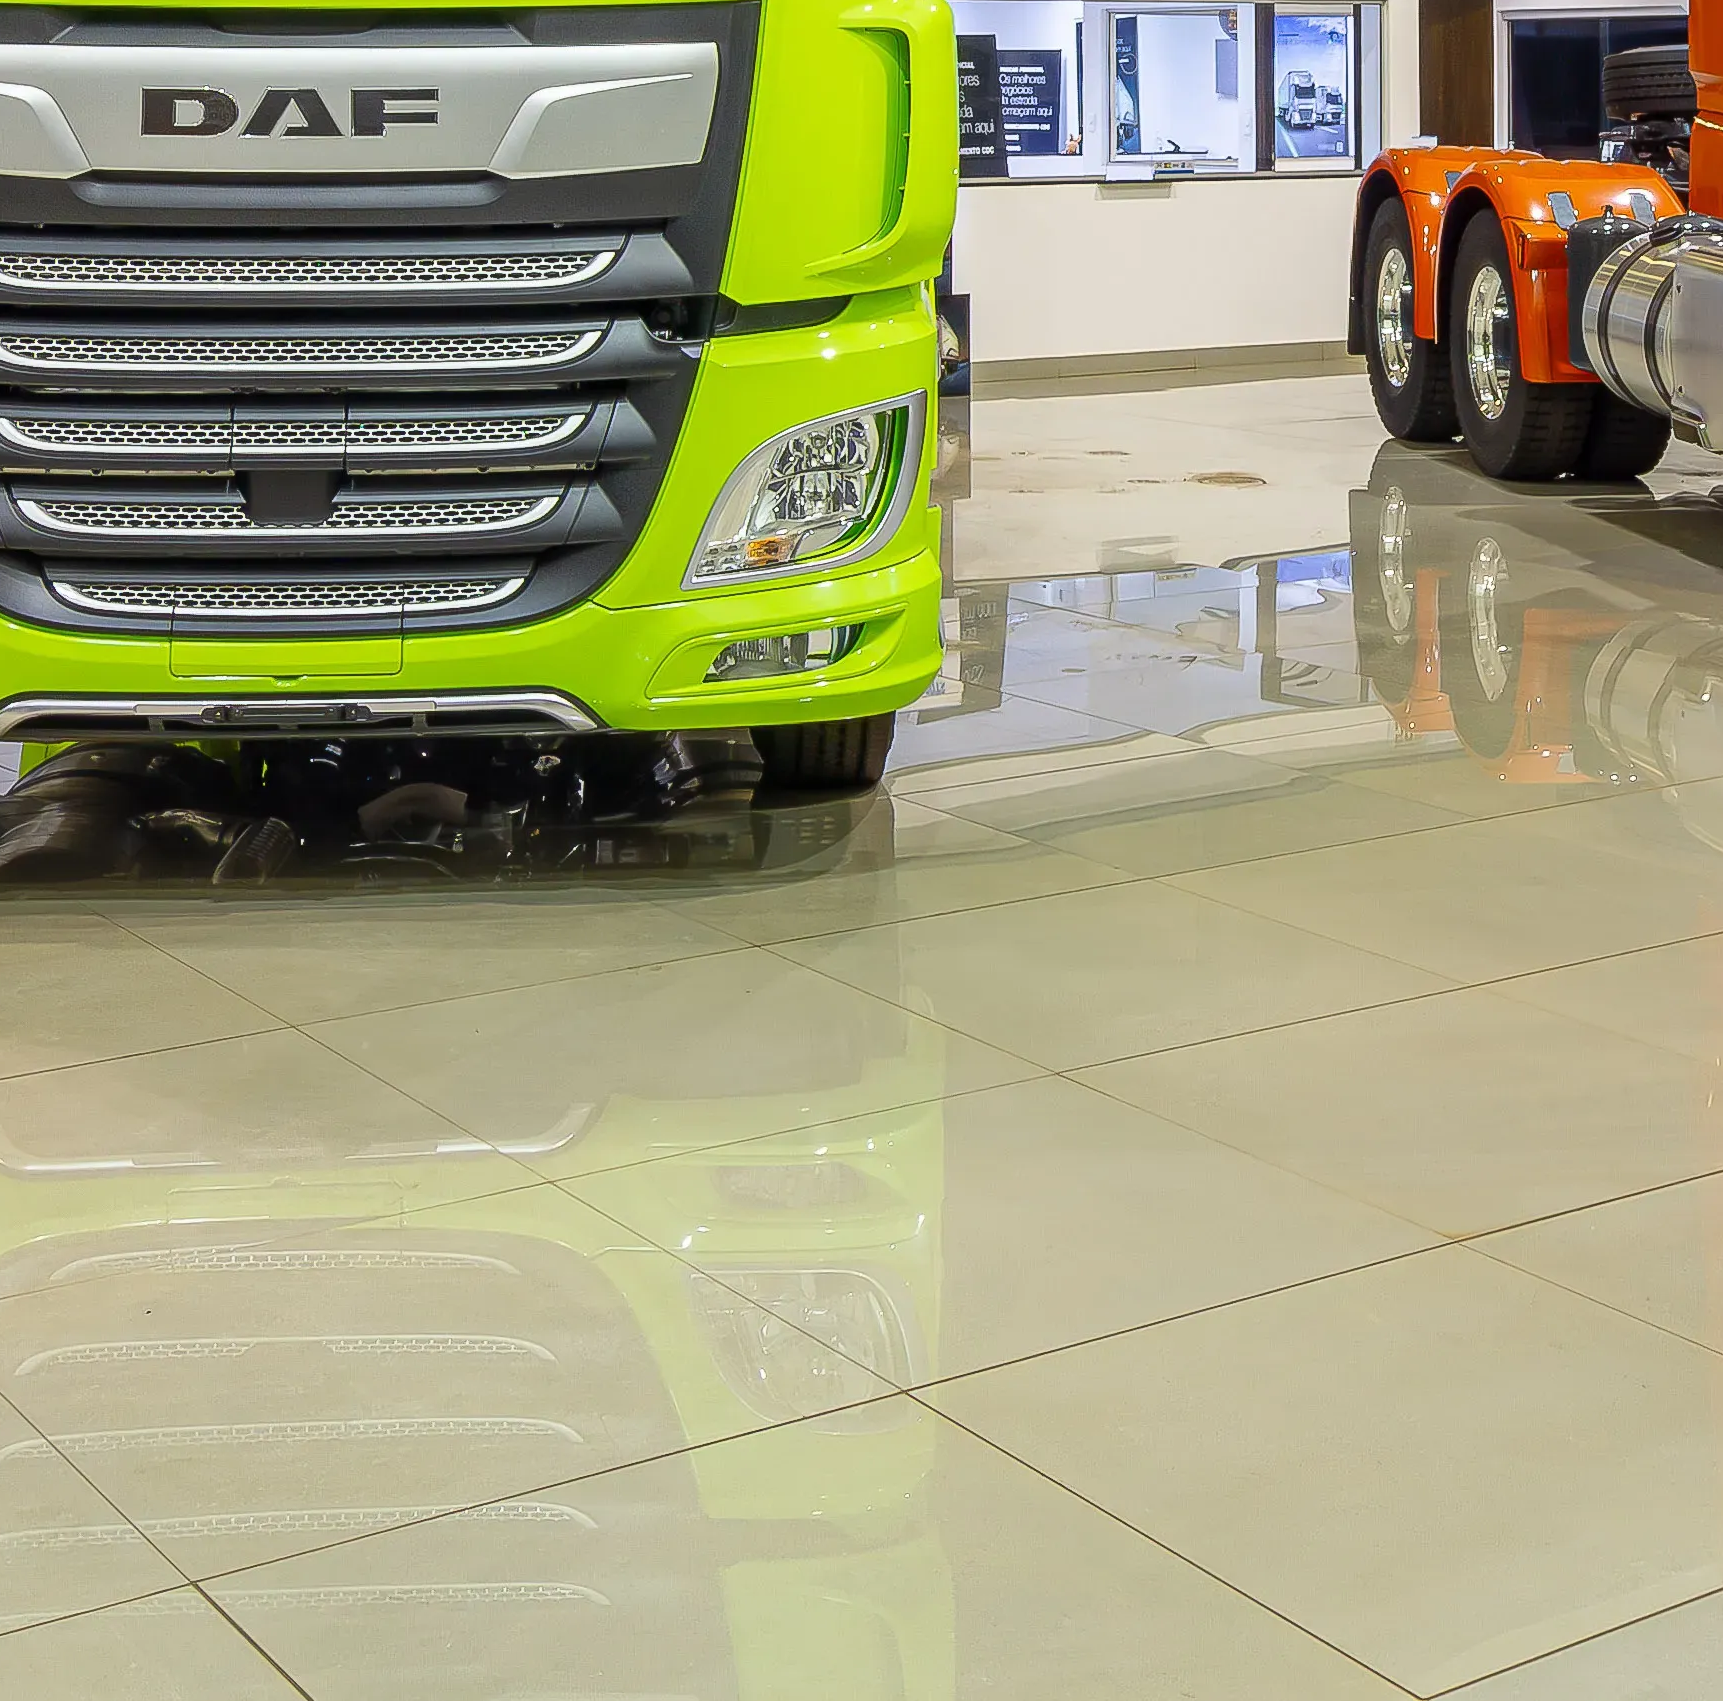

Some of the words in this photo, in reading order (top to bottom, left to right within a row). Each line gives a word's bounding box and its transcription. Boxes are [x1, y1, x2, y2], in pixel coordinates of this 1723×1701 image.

[1012, 74, 1046, 84] melhores
[140, 86, 439, 138] DAF
[1037, 106, 1053, 117] aqui
[975, 119, 995, 135] aqui
